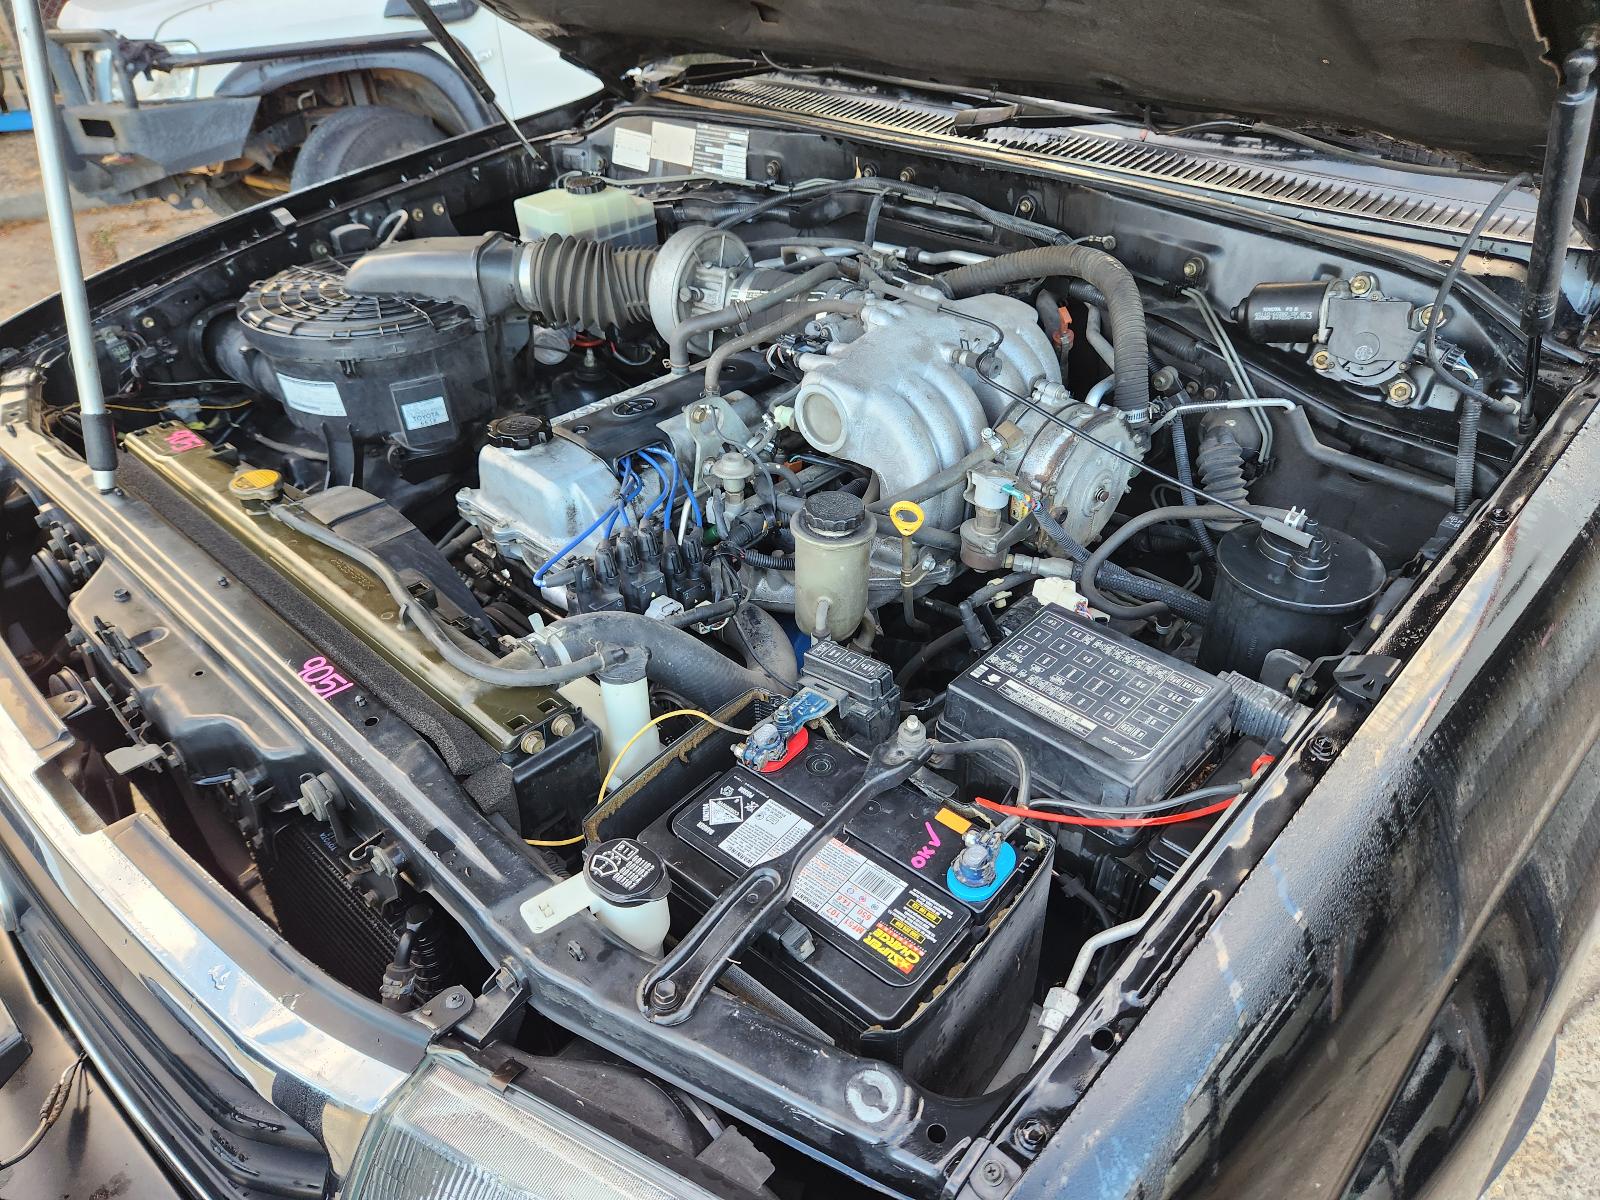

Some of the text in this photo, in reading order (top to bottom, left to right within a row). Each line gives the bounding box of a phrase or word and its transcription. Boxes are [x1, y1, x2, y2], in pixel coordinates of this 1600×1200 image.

[413, 412, 439, 421] TOYOTA
[297, 656, 354, 701] 9051
[696, 821, 715, 836] DANGER
[911, 845, 935, 868] OK
[826, 907, 841, 918] 107
[857, 909, 872, 921] 650
[844, 918, 865, 934] MF51
[862, 934, 904, 966] SUPER
[872, 928, 922, 965] CHARGE
